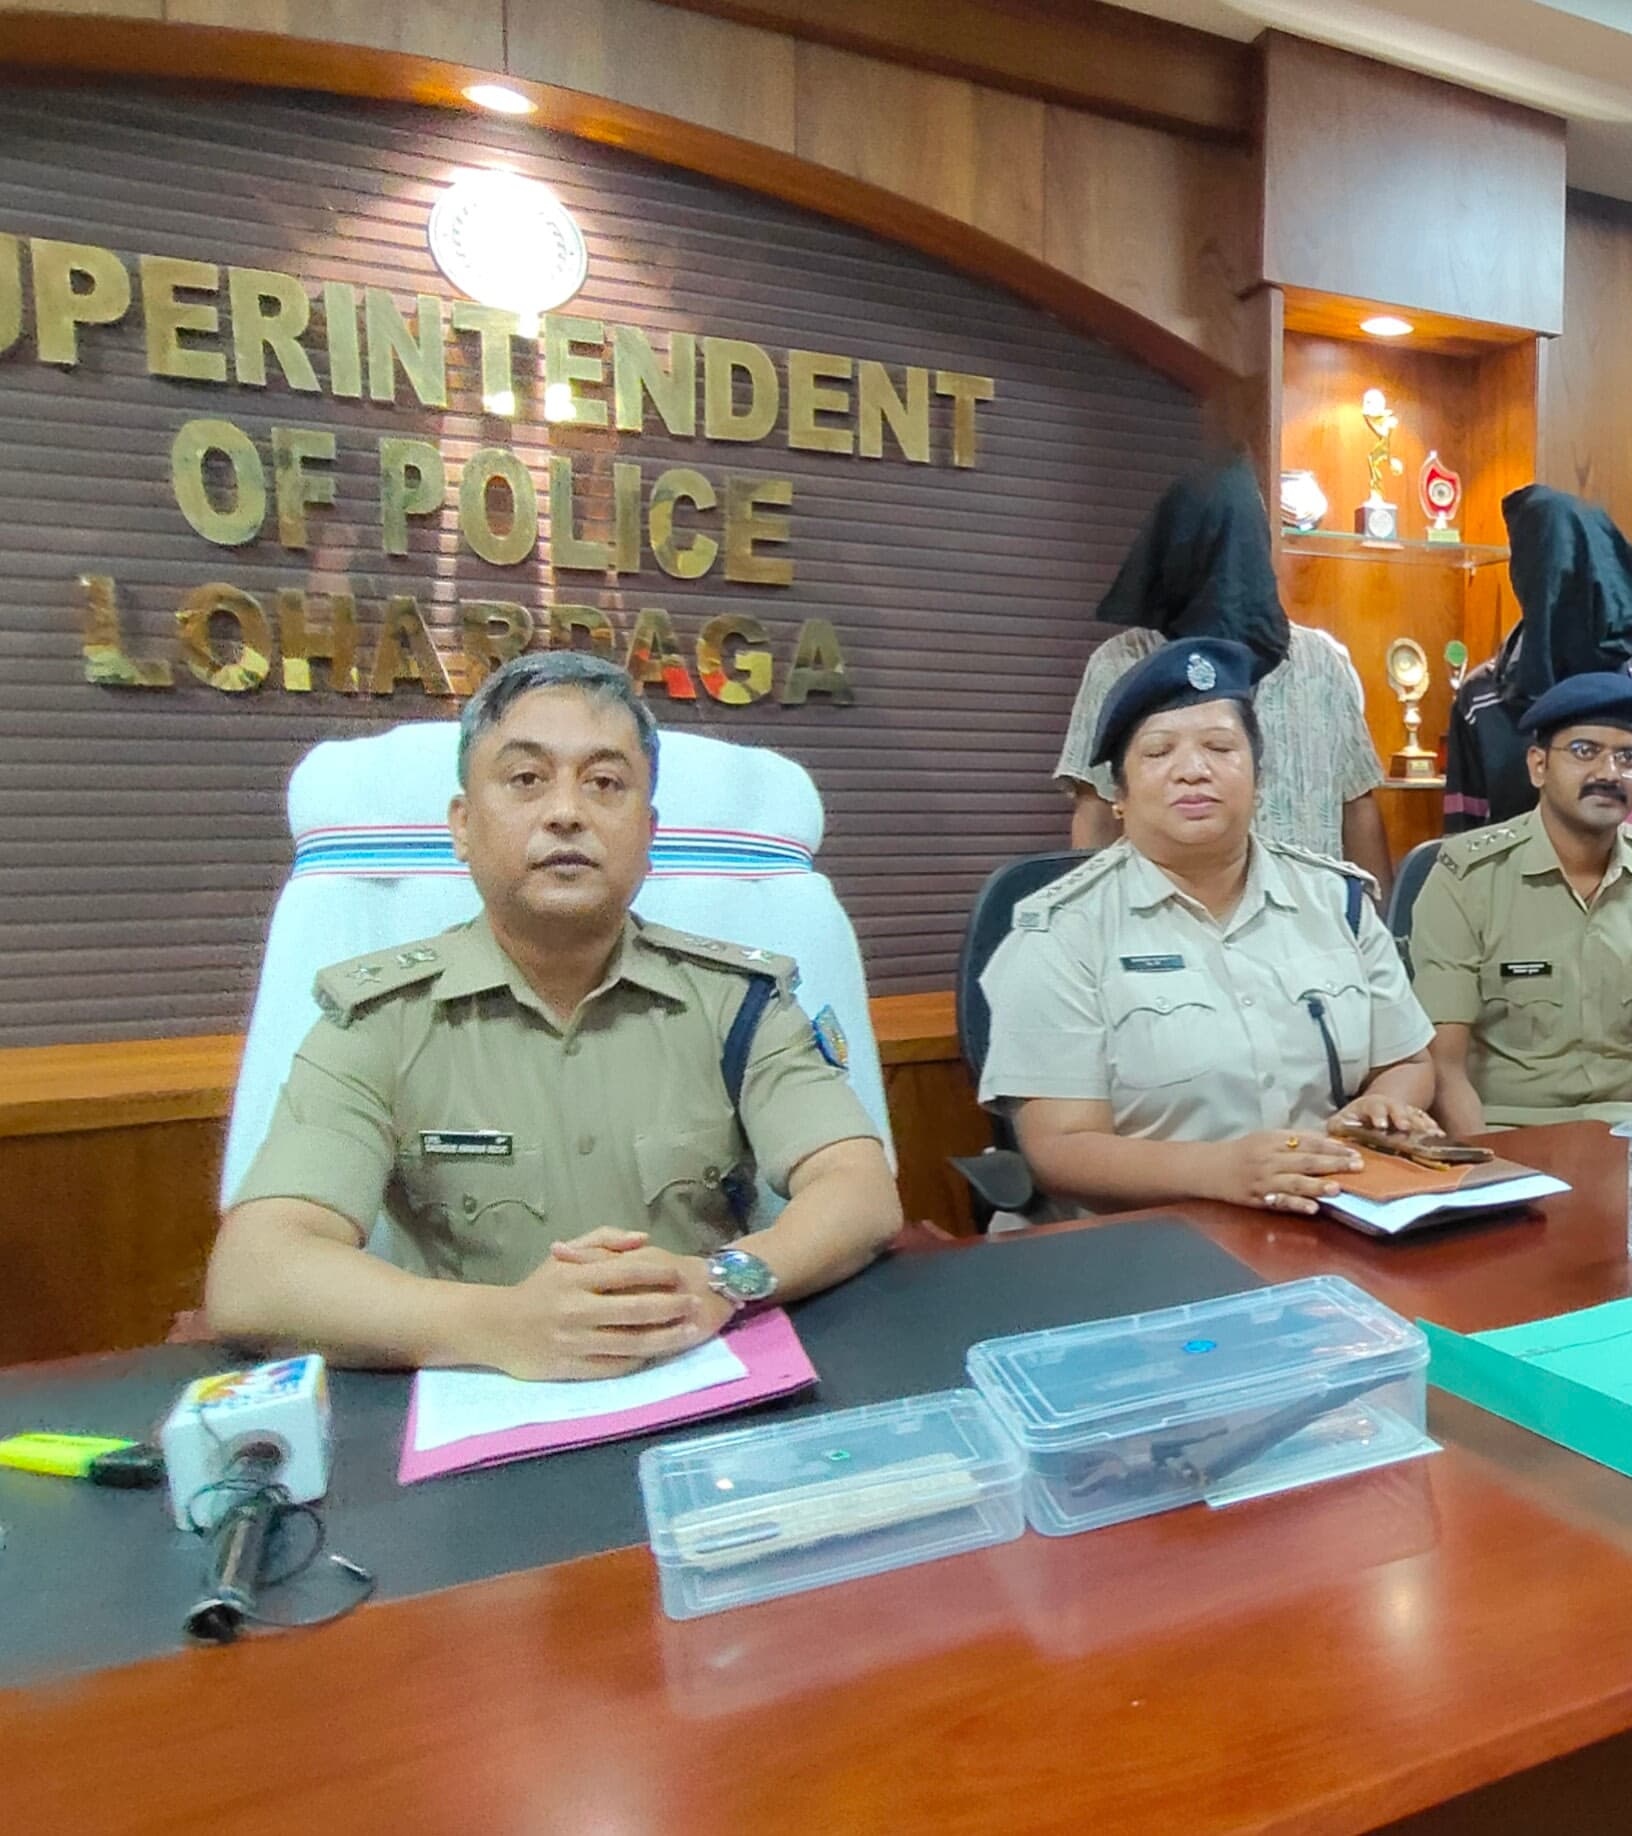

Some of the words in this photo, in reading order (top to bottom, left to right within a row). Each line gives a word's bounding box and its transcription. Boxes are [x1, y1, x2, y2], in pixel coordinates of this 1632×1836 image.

[0, 232, 996, 468] PERINTENDENT
[171, 419, 337, 549] OF
[379, 438, 794, 587] POLICE
[79, 574, 857, 705] LOHARDAGA
